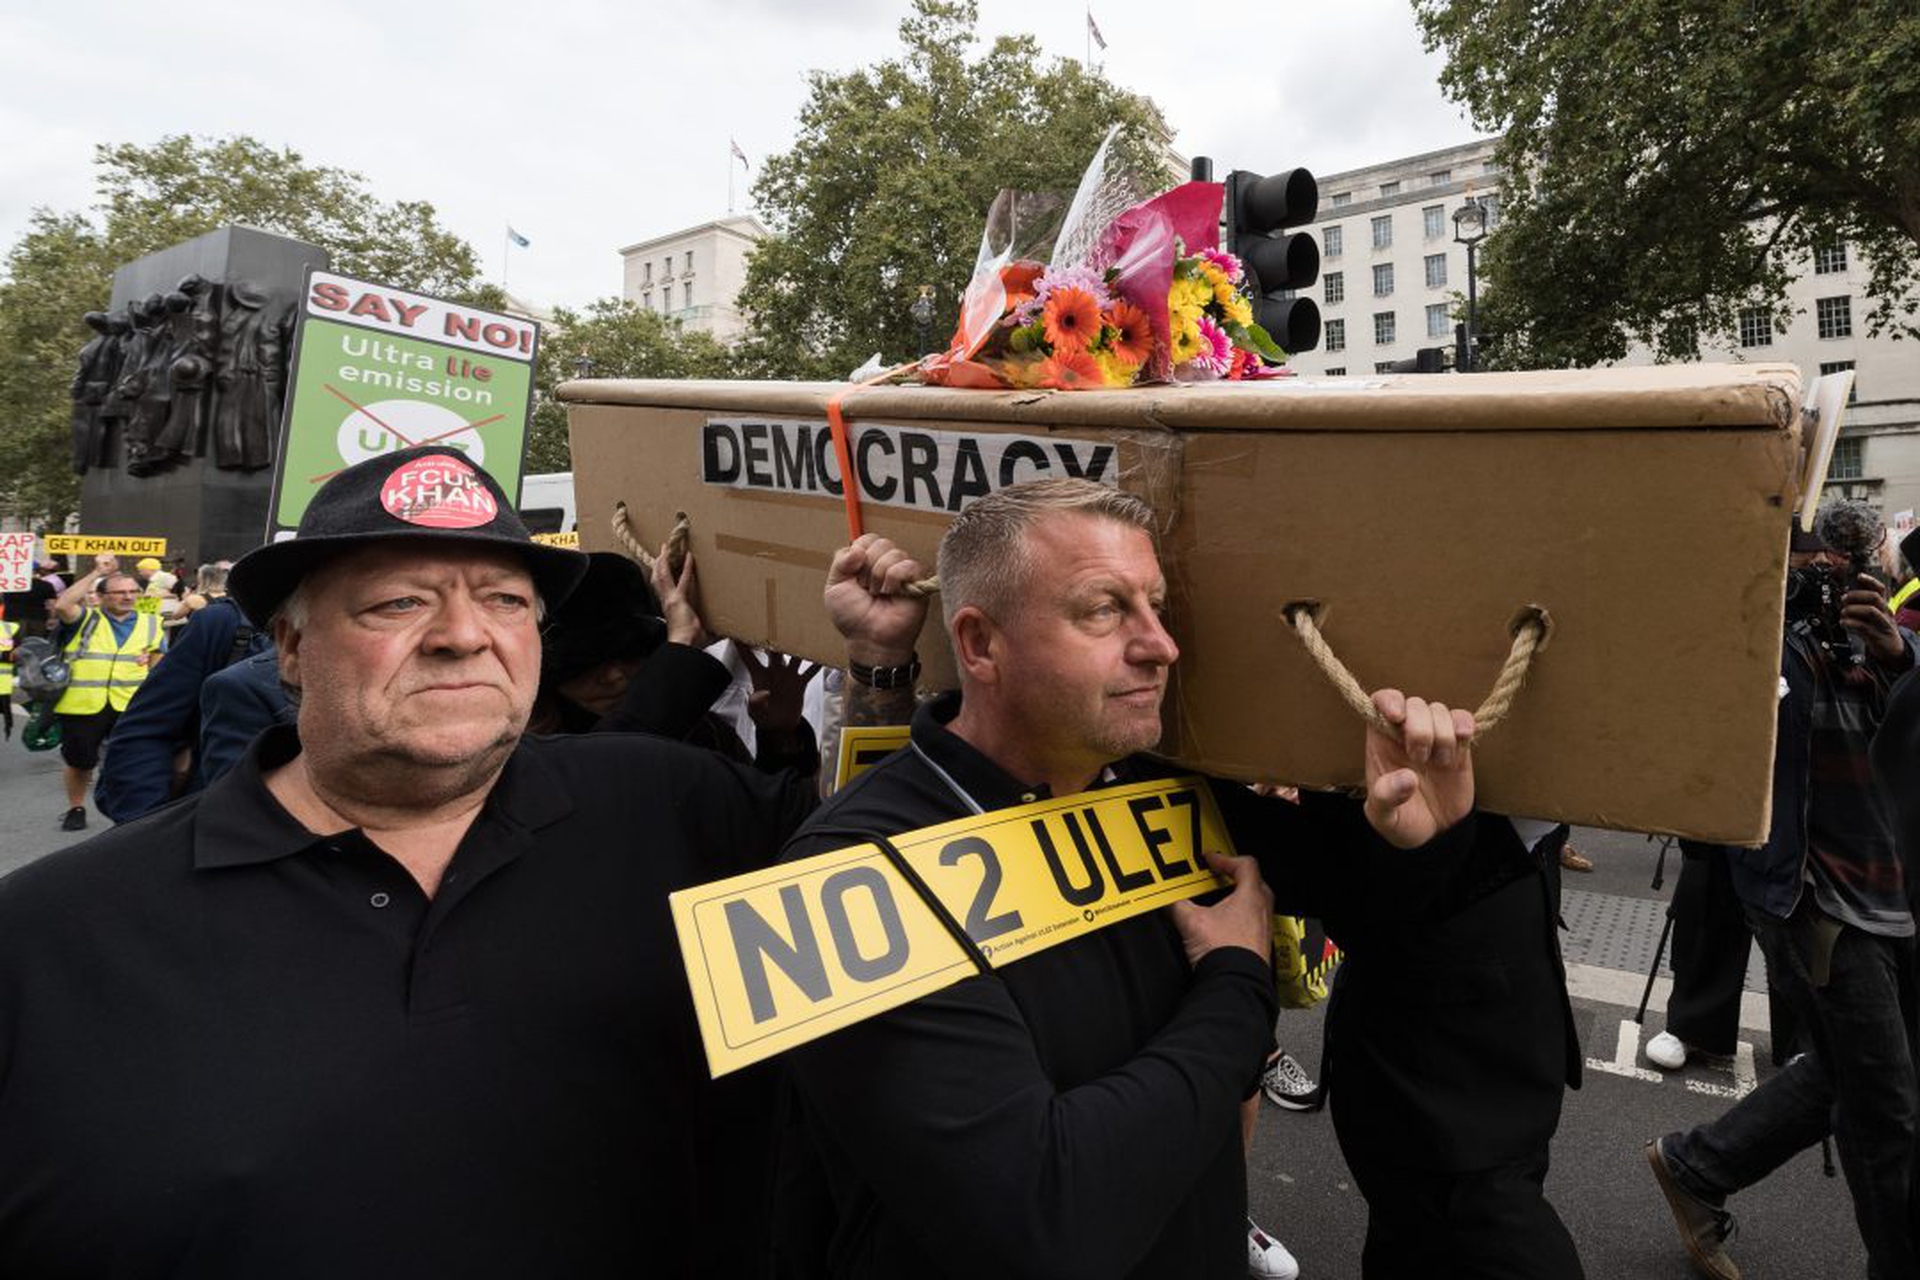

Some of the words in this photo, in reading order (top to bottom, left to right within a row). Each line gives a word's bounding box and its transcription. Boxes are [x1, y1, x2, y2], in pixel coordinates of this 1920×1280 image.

[311, 282, 428, 327] SAY
[444, 312, 532, 354] NO!
[342, 335, 434, 371] Ultra
[338, 364, 492, 405] emission
[401, 468, 480, 490] FCUK
[387, 484, 493, 513] KHAN
[49, 537, 83, 550] GET
[85, 539, 127, 551] KHAN
[131, 541, 162, 552] OUT
[724, 865, 910, 1024] NO
[938, 836, 1024, 943] 2
